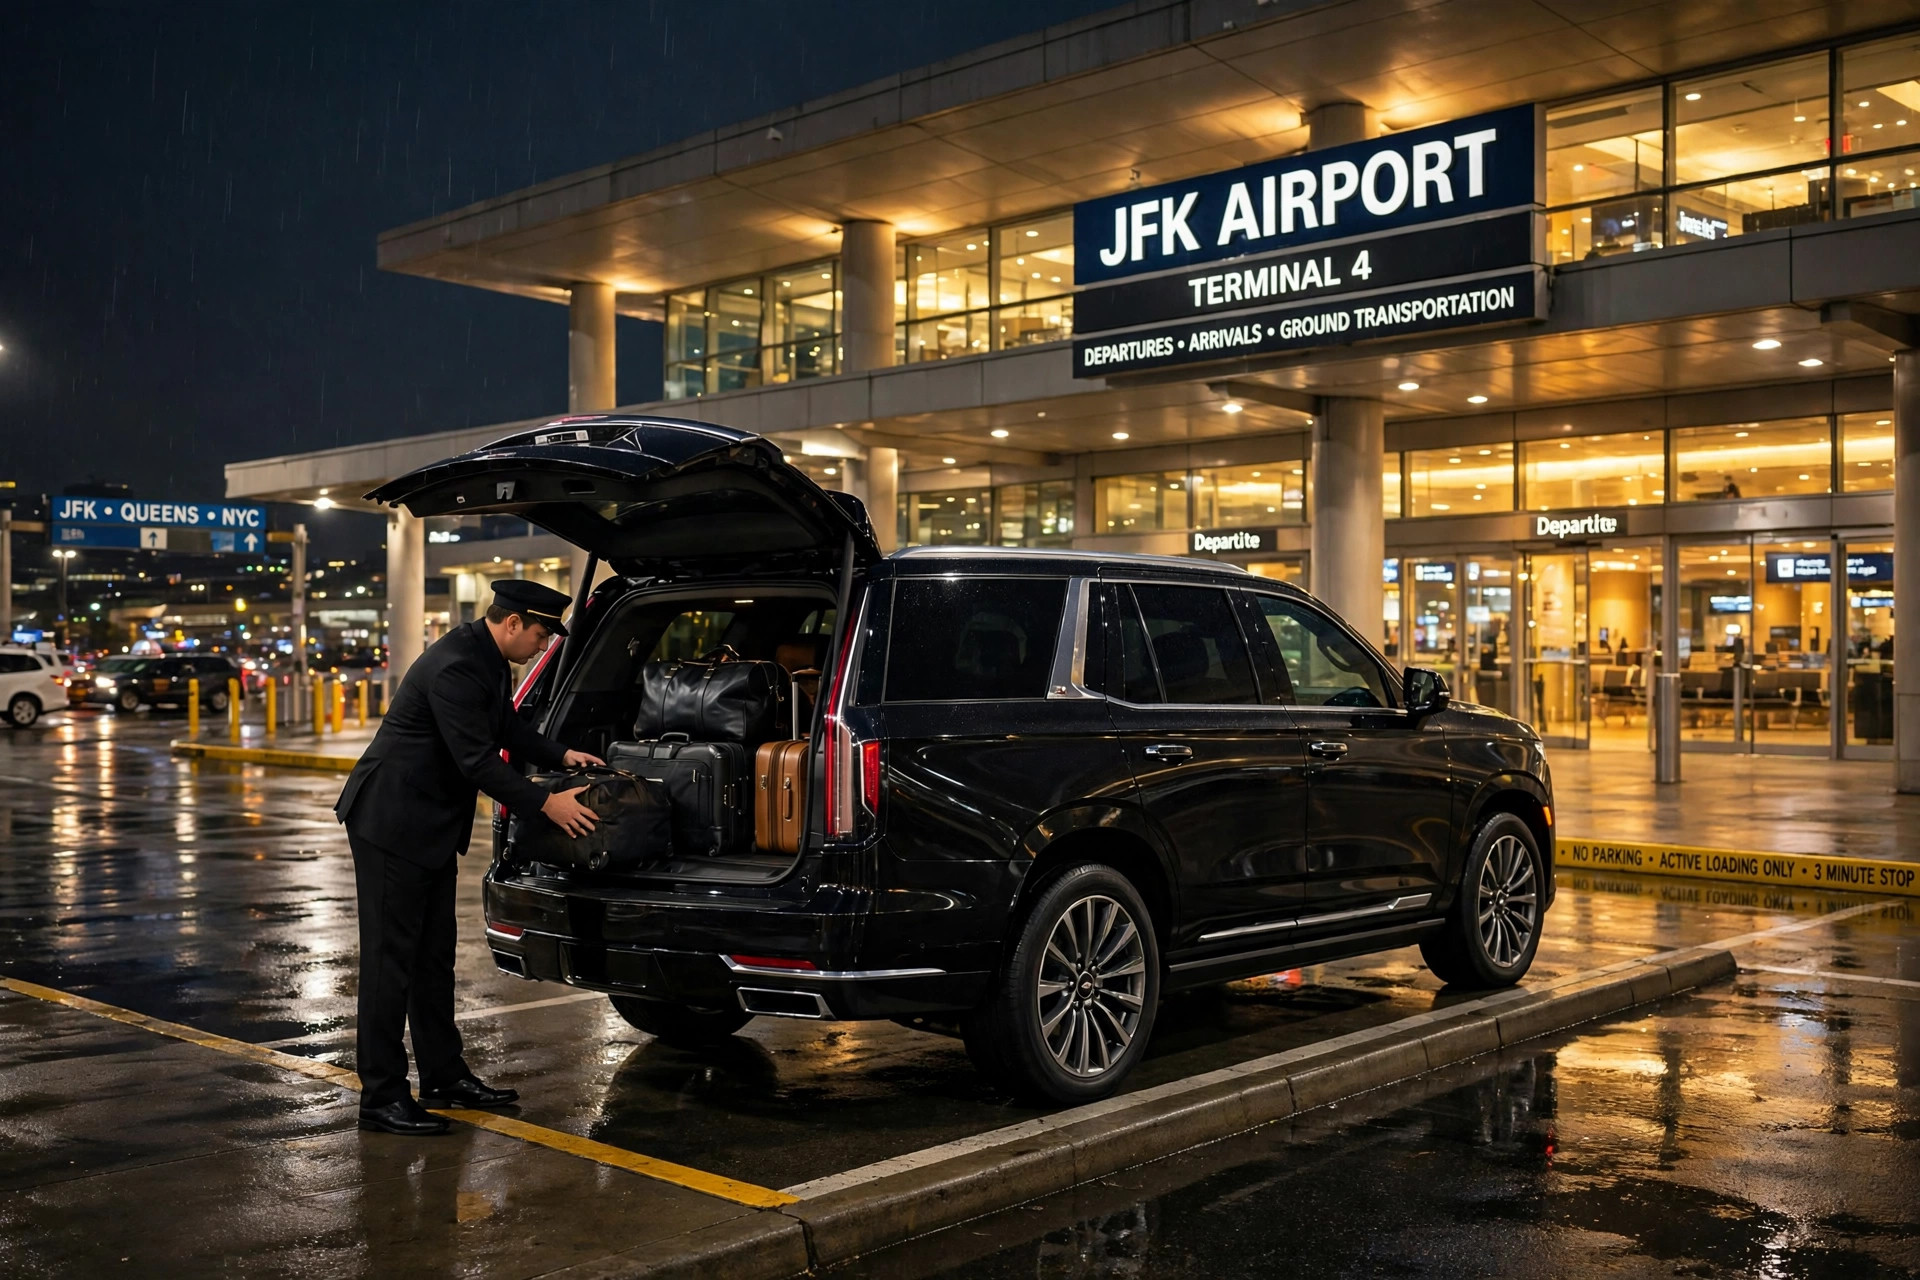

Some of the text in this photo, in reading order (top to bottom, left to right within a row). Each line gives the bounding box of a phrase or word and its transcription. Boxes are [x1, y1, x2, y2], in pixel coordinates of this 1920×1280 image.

[1099, 128, 1497, 267] JFK AIRPORT
[1188, 250, 1372, 307] TERMINAL 4
[1084, 286, 1515, 366] DEPARTURES ARRIVALS GROUND TRANSPORTATION
[59, 500, 260, 527] JFK QUEENS NYC
[1572, 845, 1915, 888] NO PARKING ACTIVE LOADING ONLY 3 MINUTE STOP
